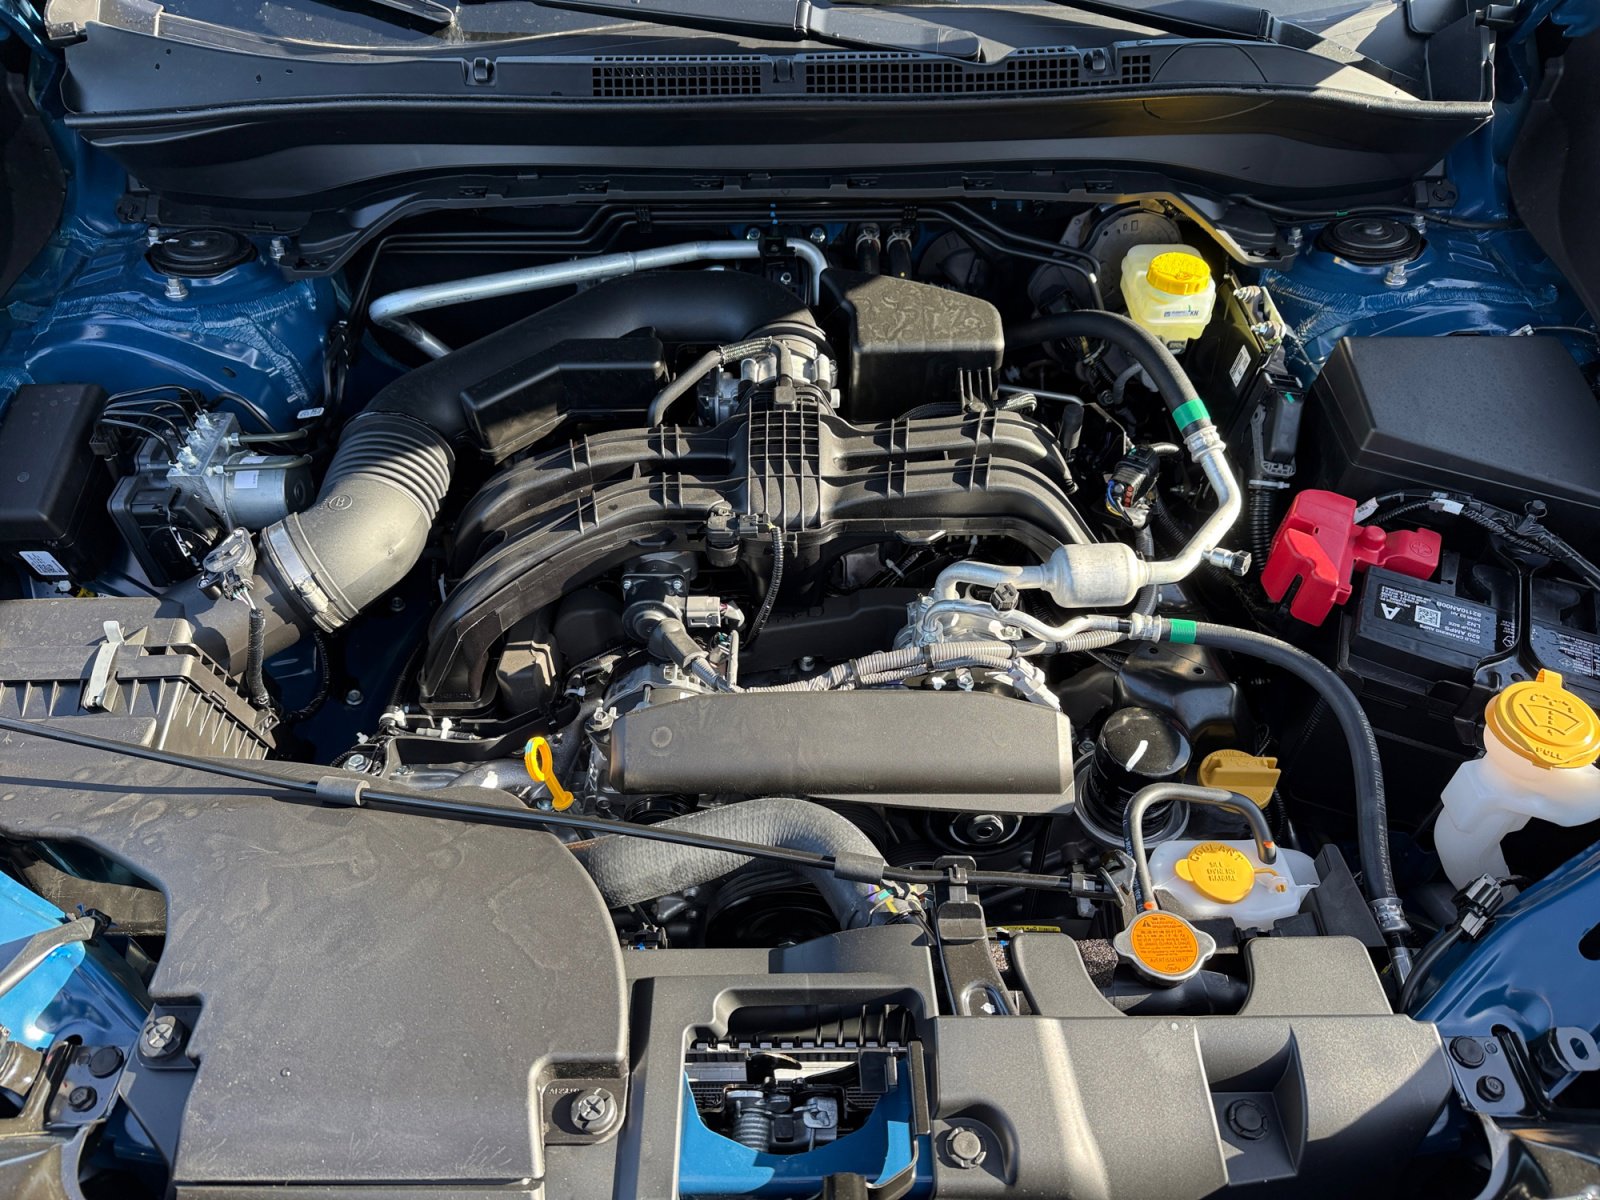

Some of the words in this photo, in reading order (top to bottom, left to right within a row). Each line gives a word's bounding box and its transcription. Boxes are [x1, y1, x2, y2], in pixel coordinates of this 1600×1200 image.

[1381, 603, 1401, 620] A
[1420, 624, 1435, 632] AMPS
[1467, 621, 1480, 629] LN2
[1445, 626, 1466, 636] AMPS
